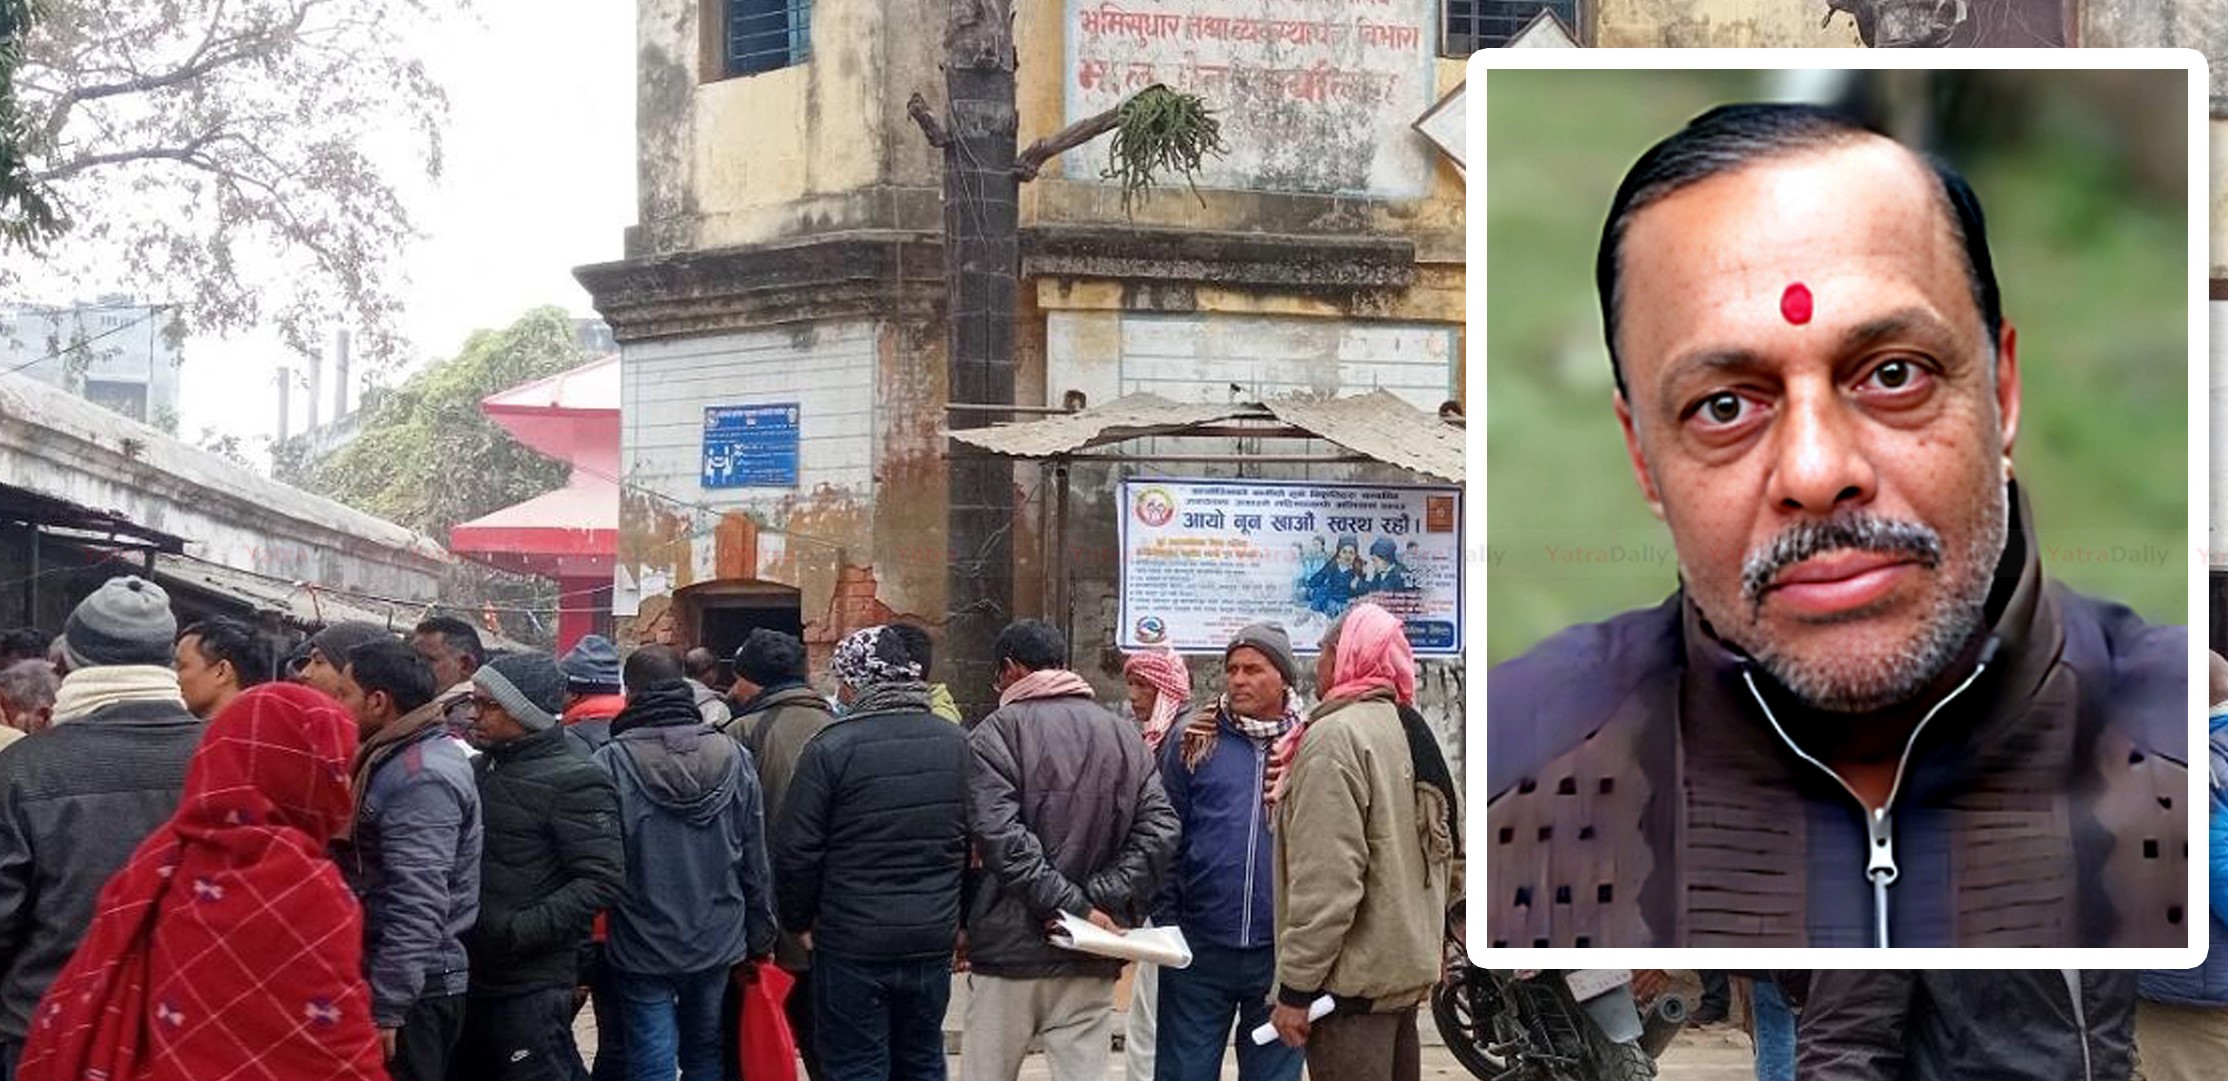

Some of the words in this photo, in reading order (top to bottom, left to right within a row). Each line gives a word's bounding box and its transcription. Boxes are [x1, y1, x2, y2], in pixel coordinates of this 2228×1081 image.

[1357, 16, 1419, 50] विभाग
[1182, 508, 1226, 530] आयो
[1233, 513, 1262, 536] नून
[1326, 515, 1374, 533] स्वस्थ
